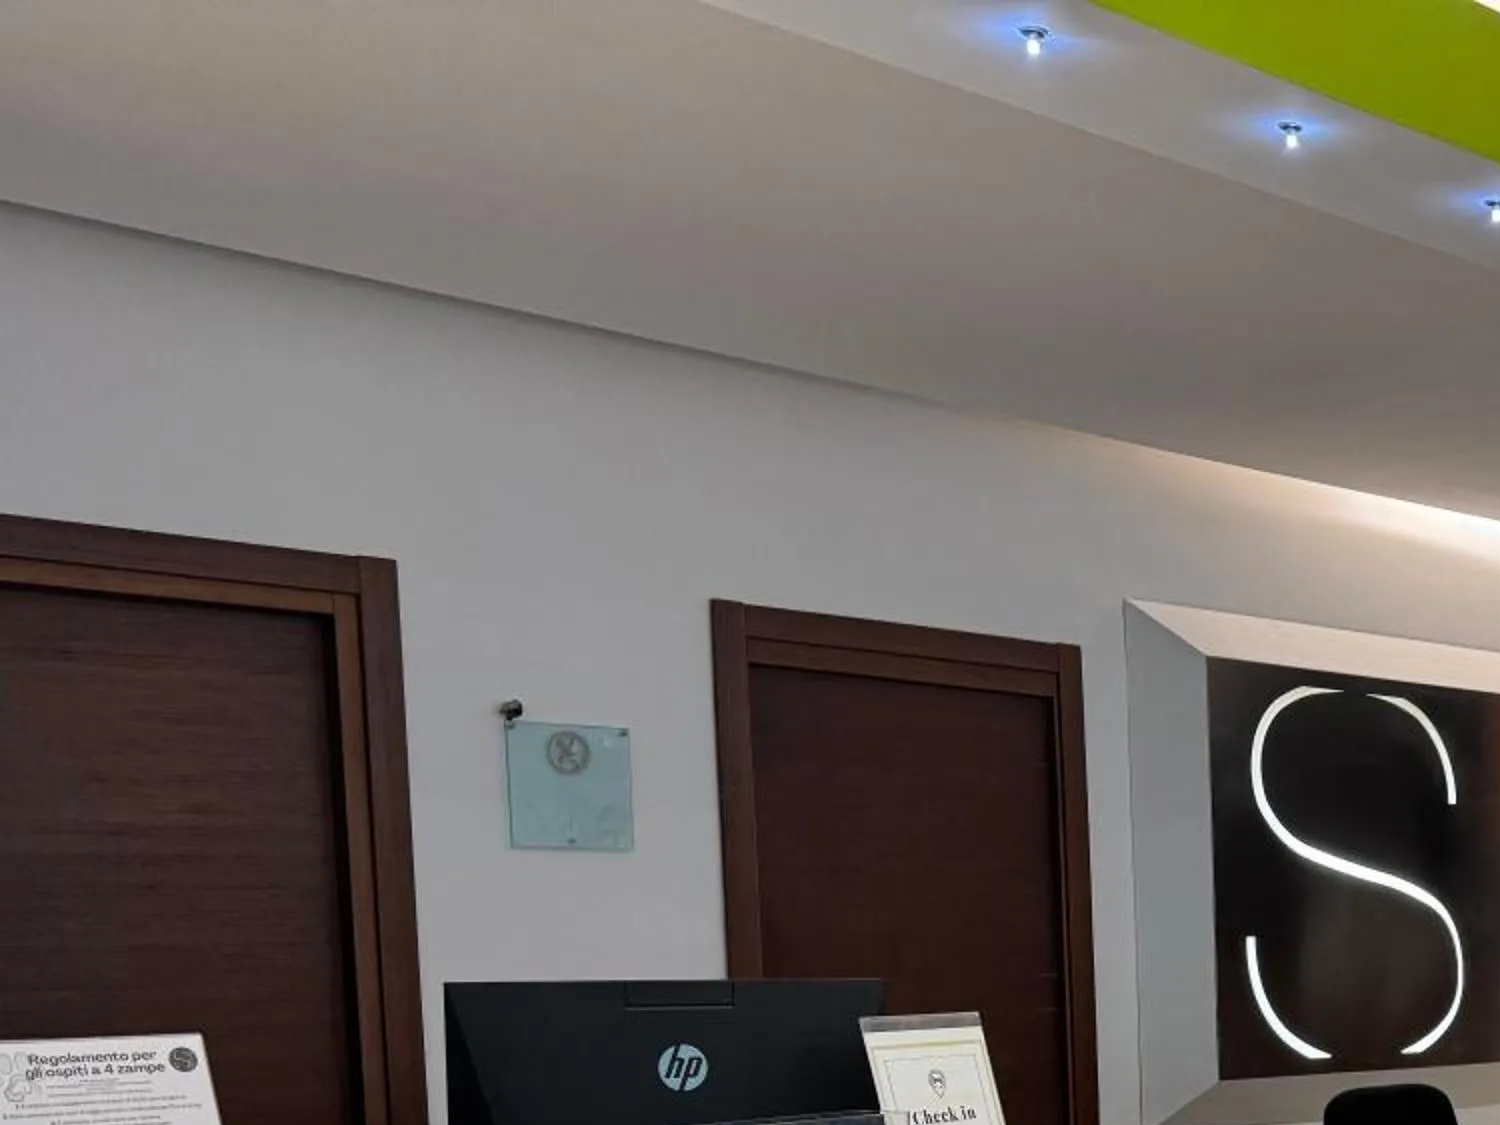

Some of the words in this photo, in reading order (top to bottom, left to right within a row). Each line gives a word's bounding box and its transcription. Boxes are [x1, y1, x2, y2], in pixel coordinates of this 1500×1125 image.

[1246, 685, 1463, 1059] S
[27, 1052, 129, 1066] Regolamento
[132, 1050, 158, 1062] per
[664, 1044, 704, 1091] hp
[25, 1067, 43, 1080] gli
[45, 1064, 89, 1078] ospiti
[91, 1066, 101, 1074] a
[104, 1062, 114, 1074] 4
[117, 1062, 166, 1074] zampe
[912, 1106, 959, 1125] Check
